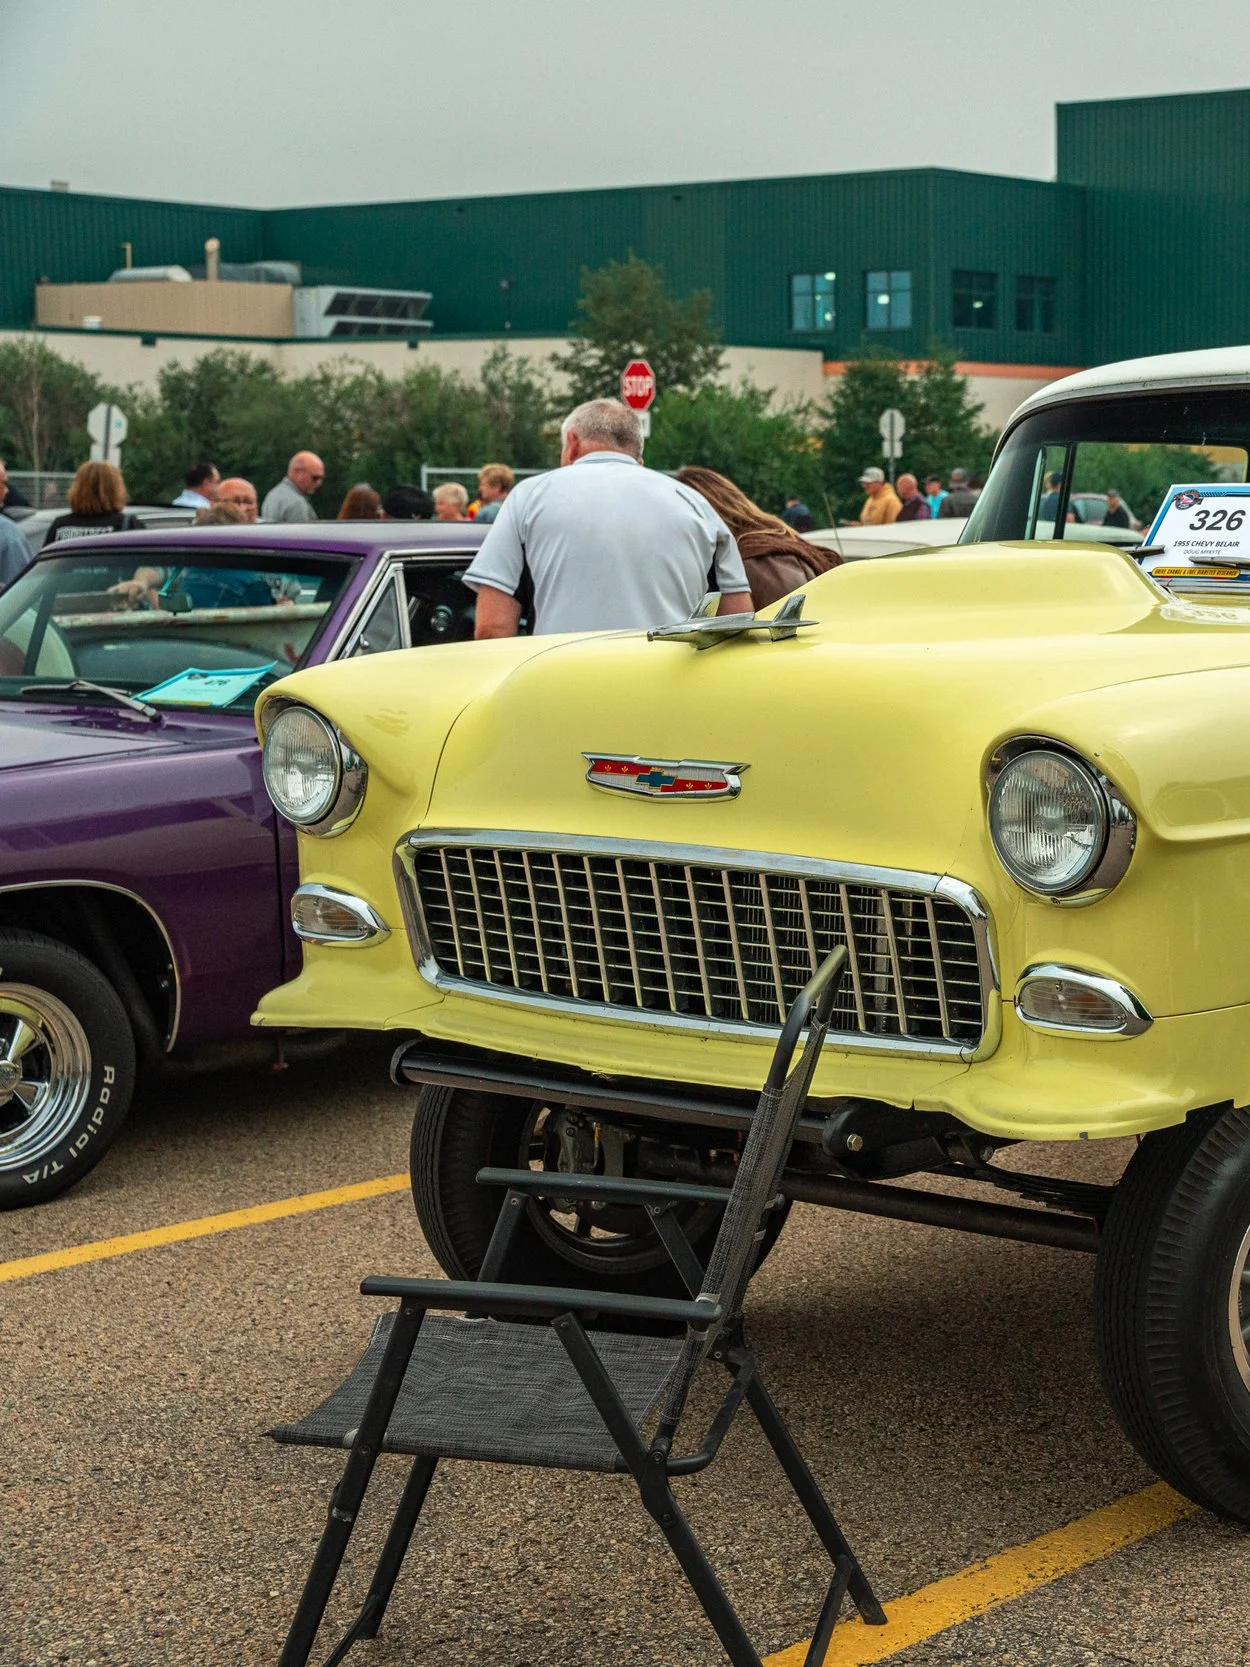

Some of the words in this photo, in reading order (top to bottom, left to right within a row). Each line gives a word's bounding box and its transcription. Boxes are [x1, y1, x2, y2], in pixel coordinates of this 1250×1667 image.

[622, 375, 653, 397] STOP
[1189, 509, 1246, 531] 326
[69, 1065, 115, 1158] Radial
[22, 1160, 64, 1185] T/A
